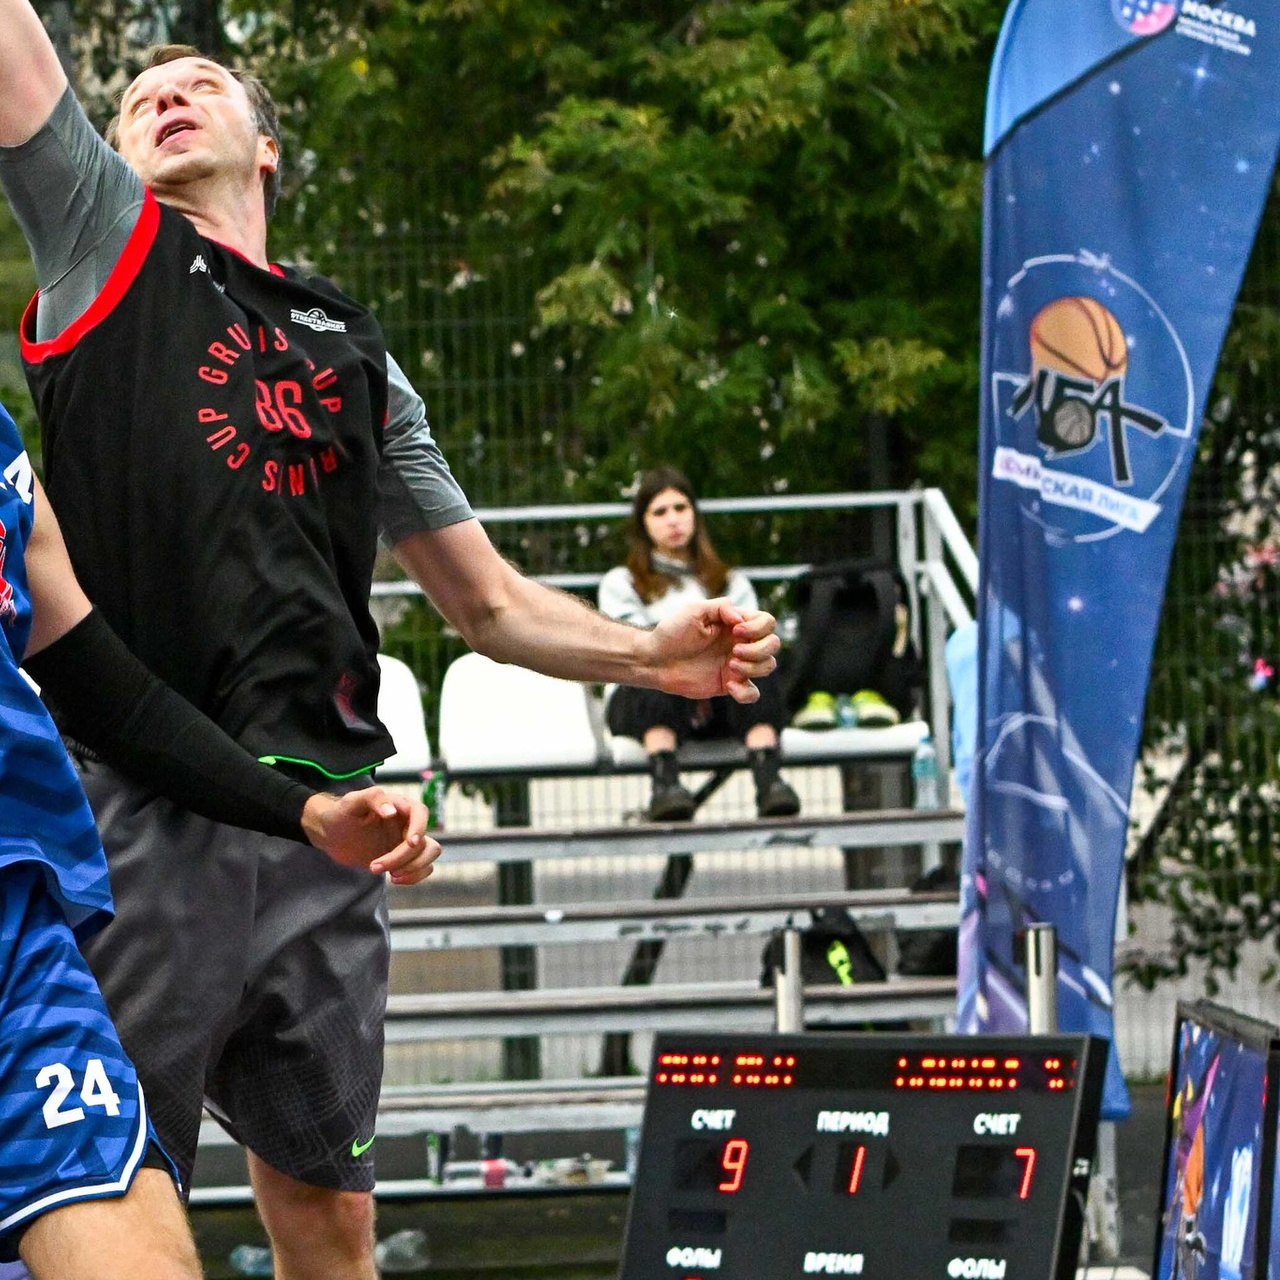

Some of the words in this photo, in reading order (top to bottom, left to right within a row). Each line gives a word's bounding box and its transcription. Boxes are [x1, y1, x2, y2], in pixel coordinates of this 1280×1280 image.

[34, 1058, 121, 1130] 24
[690, 1108, 737, 1131] СЧЕТ
[816, 1110, 891, 1136] ПЕРИОД
[972, 1113, 1022, 1135] СЧЕТ
[718, 1137, 749, 1193] 9
[847, 1145, 867, 1195] 1
[1015, 1147, 1037, 1200] 7
[665, 1246, 723, 1269] ФОЛЫ
[802, 1251, 865, 1275] ВРЕМЯ
[947, 1257, 1007, 1280] ФОЛЫ
